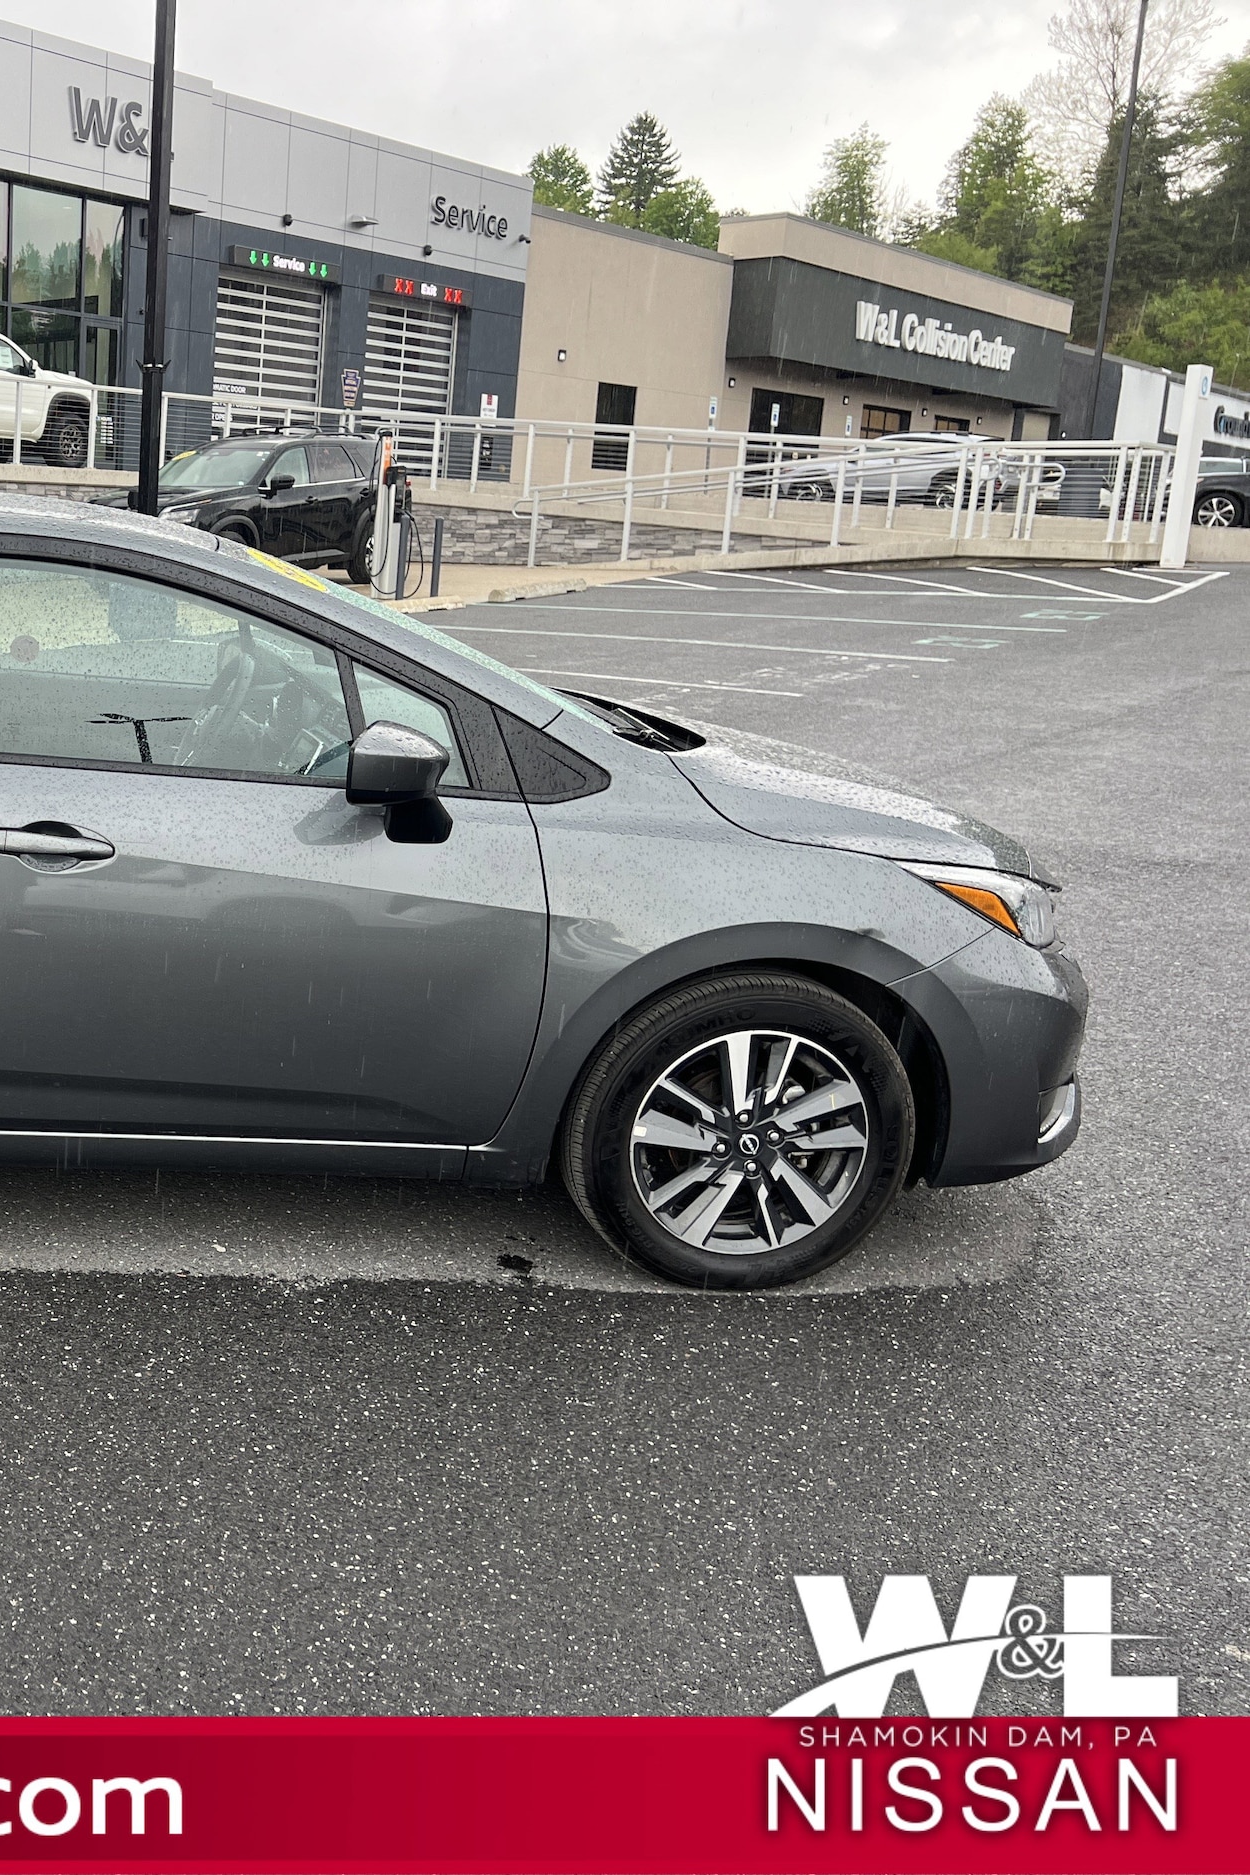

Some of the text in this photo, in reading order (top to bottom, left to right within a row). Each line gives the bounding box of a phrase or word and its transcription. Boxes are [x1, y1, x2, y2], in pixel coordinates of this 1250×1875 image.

[69, 86, 174, 161] W&
[431, 196, 508, 239] Service
[272, 254, 306, 272] Service
[420, 282, 438, 297] Exit
[856, 300, 1016, 371] W&L Collision Center
[1214, 405, 1250, 438] Ground
